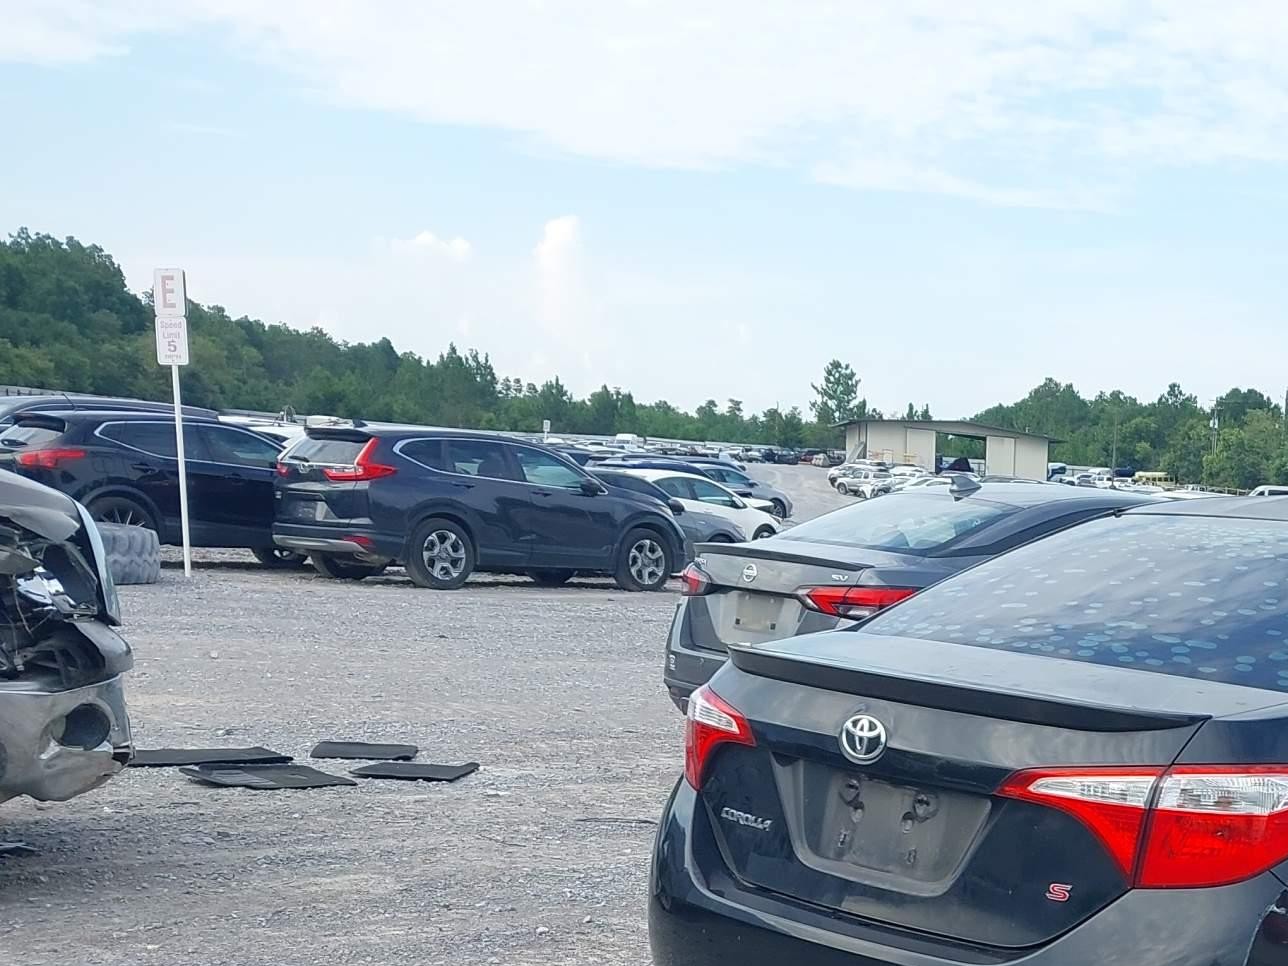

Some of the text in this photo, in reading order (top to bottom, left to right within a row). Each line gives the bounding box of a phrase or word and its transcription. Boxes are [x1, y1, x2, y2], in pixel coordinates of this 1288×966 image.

[160, 274, 177, 309] E
[167, 340, 177, 353] 5
[831, 574, 849, 582] SV
[720, 806, 773, 832] COROLLA
[1045, 883, 1073, 902] S
